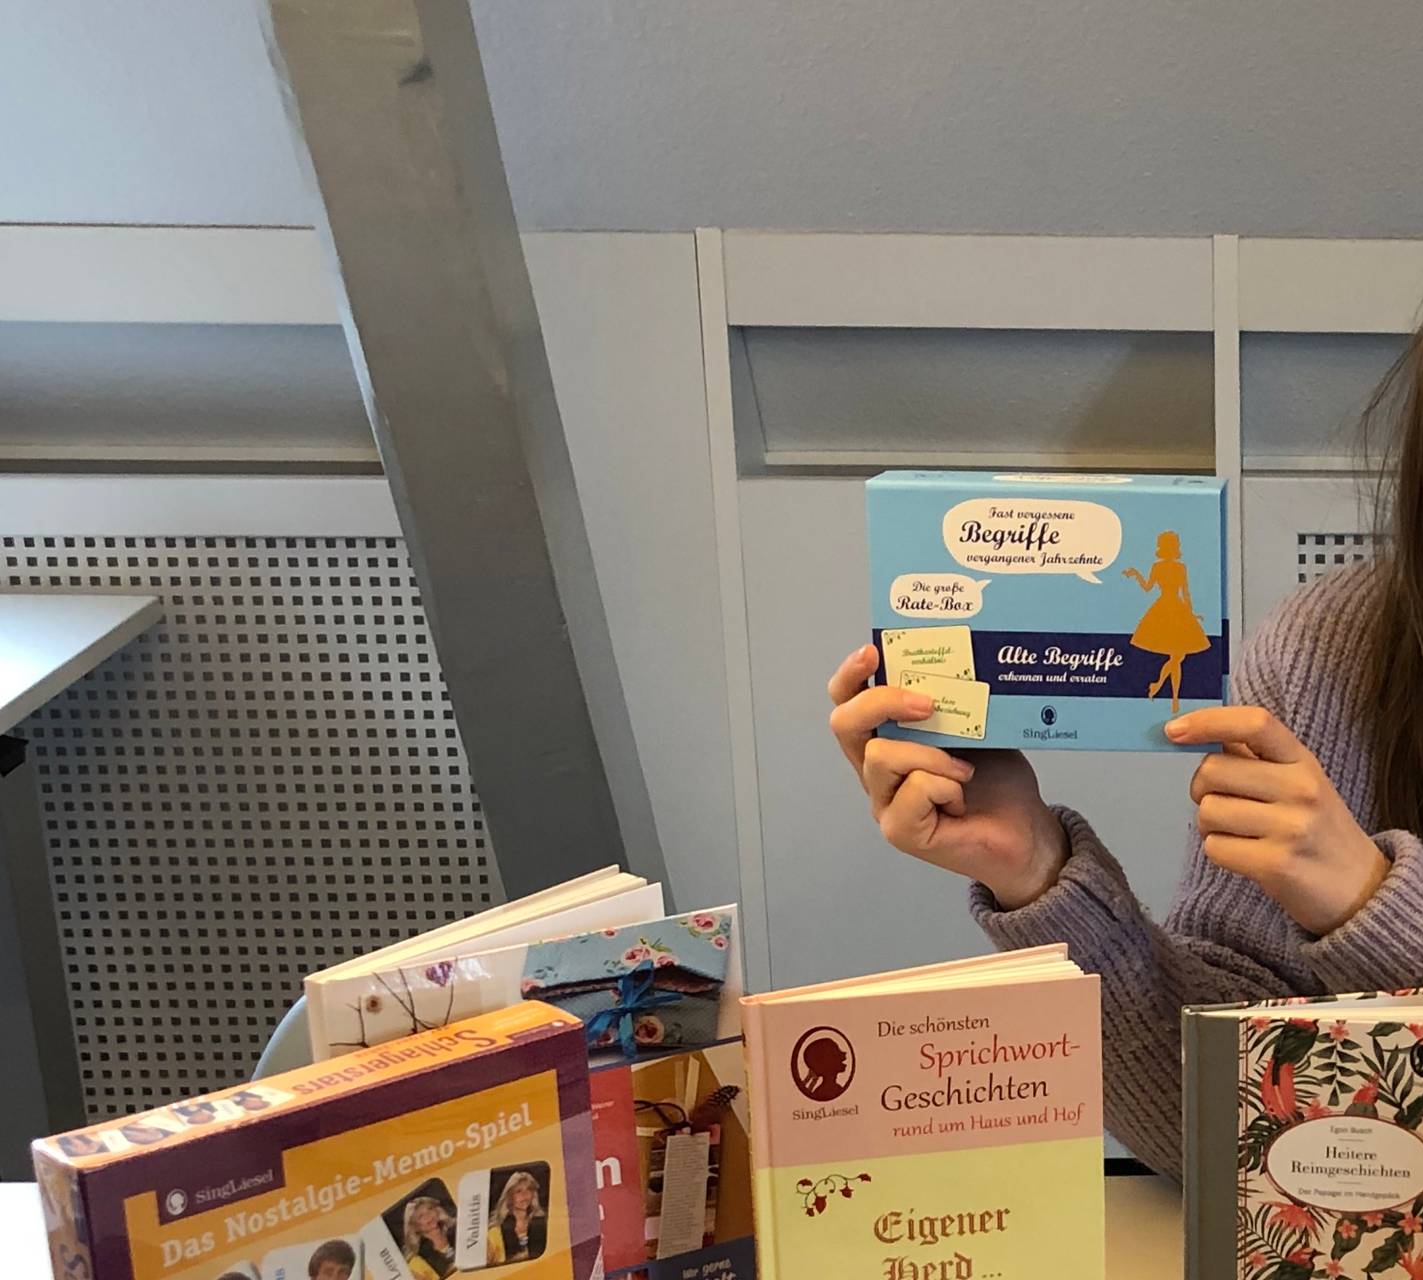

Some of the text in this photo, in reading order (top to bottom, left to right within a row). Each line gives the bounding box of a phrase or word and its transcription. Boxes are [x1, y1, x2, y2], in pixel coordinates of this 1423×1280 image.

[988, 507, 1075, 522] Fast vergessene
[959, 520, 1061, 551] Begriffe
[966, 552, 1104, 567] vergangener Jahrzehnte
[912, 581, 965, 596] Die große
[895, 595, 974, 611] Rate-Box
[997, 645, 1124, 671] Alte Begriffe
[998, 671, 1107, 684] erkennen und erraten
[1023, 728, 1078, 741] SingLiesel
[877, 1015, 990, 1038] Die schönsten
[291, 1029, 497, 1095] Schlagerstars
[919, 1033, 1081, 1078] Sprichwort-
[881, 1072, 1049, 1112] Geschichten
[792, 1104, 859, 1121] SingLiesel
[893, 1102, 1087, 1138] rund um Haus und Hof
[1325, 1145, 1377, 1161] Heitere
[1291, 1160, 1412, 1179] Reimgeschichten
[160, 1103, 533, 1267] Das Nostalgie-Memo-Spiel
[195, 1169, 274, 1203] SingLiesel
[873, 1208, 1011, 1246] Eigener
[881, 1251, 973, 1280] Herd
